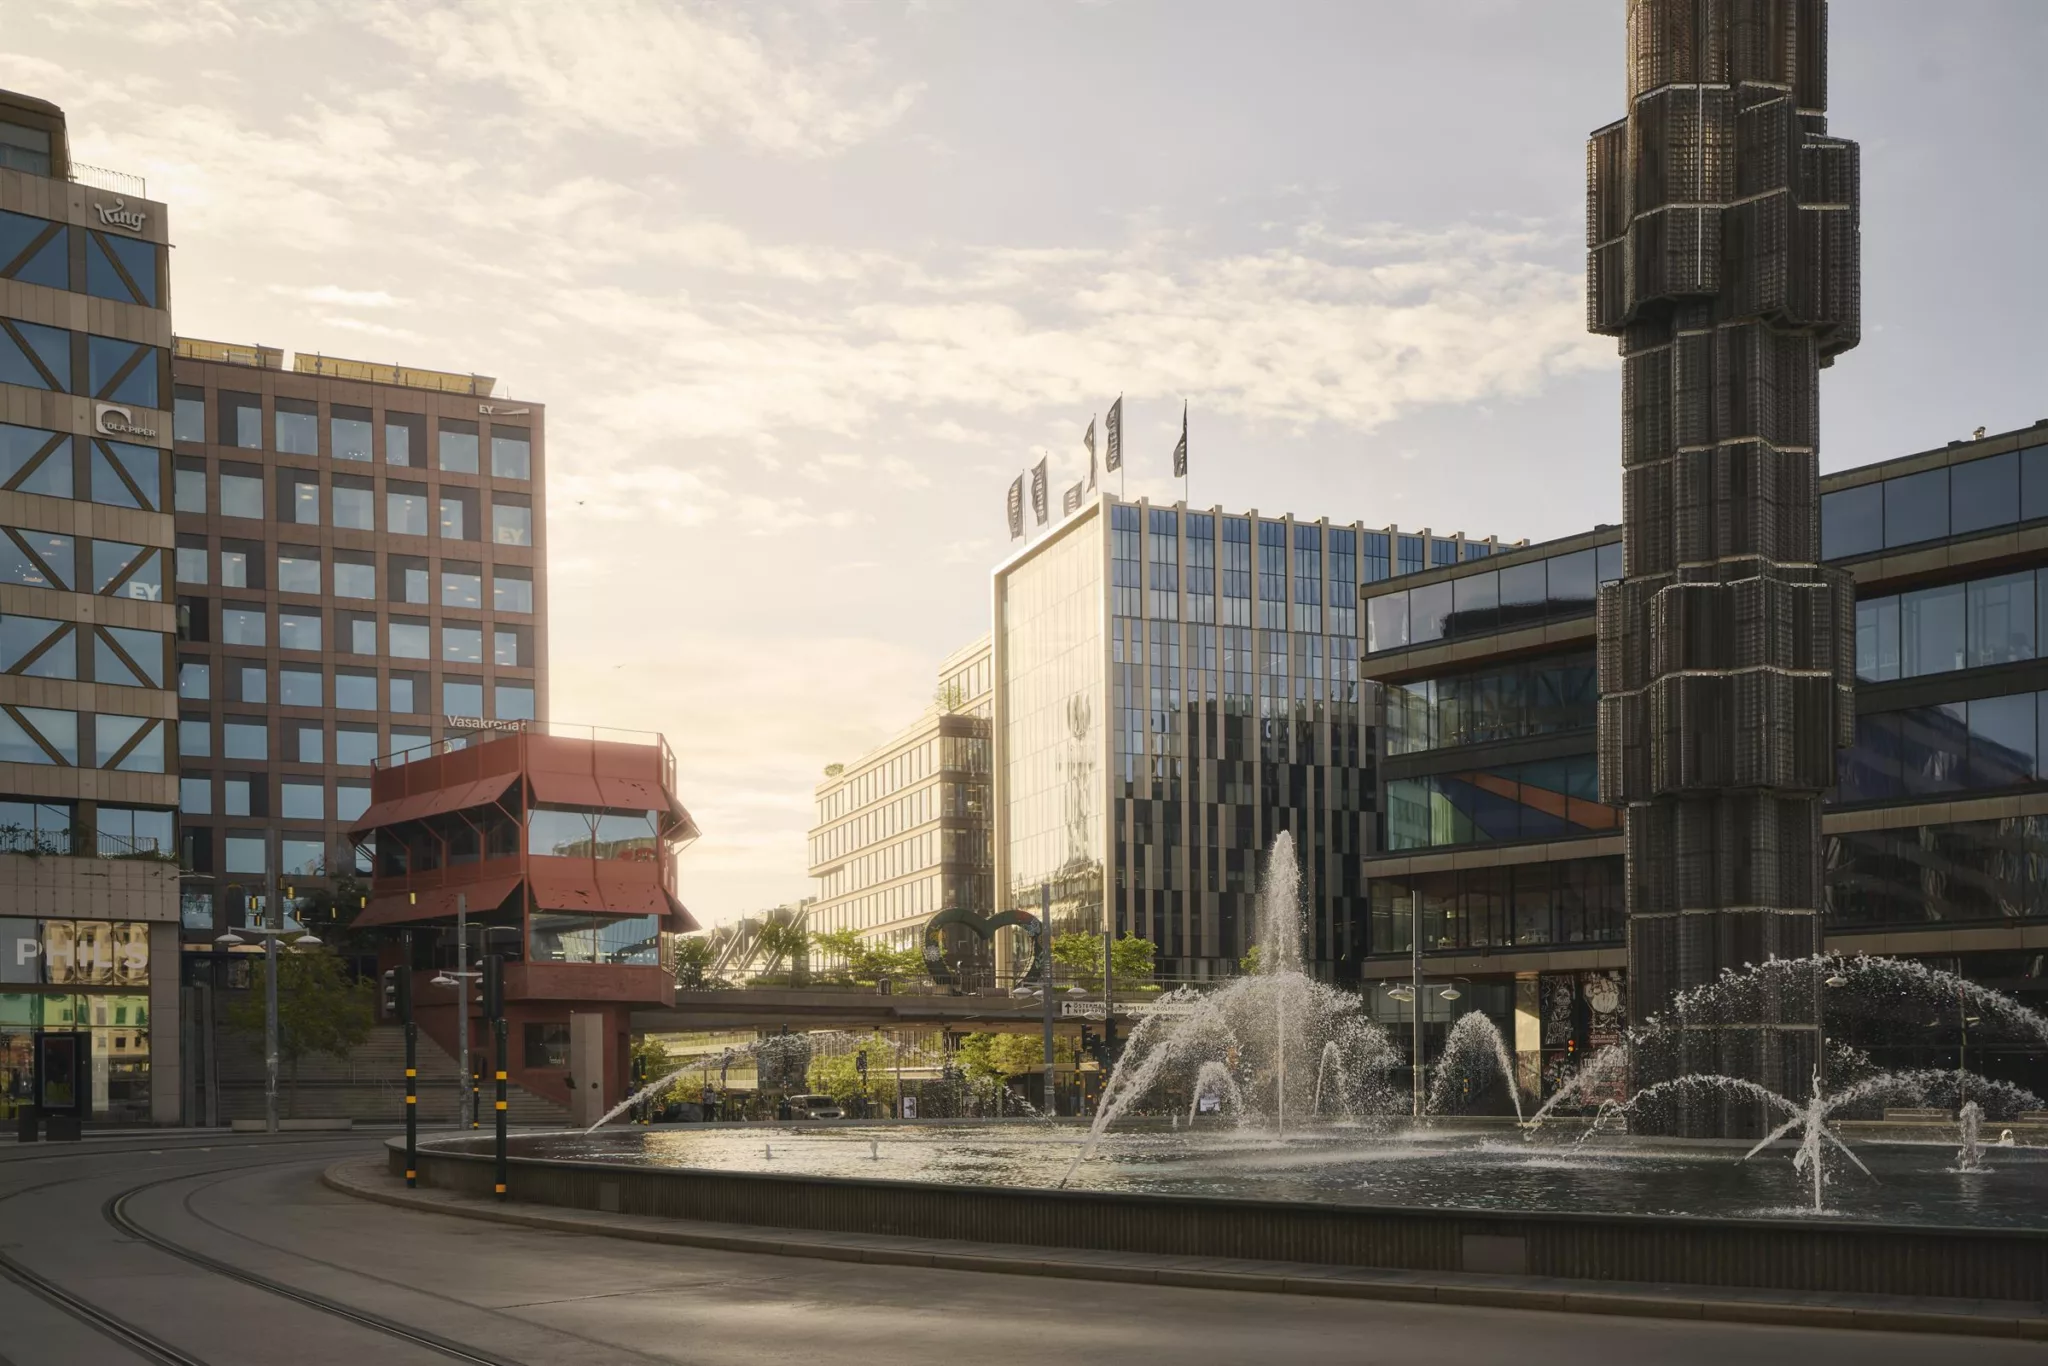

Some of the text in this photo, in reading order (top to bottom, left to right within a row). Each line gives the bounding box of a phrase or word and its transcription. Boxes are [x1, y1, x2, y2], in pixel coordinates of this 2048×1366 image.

[94, 198, 146, 231] King
[479, 404, 494, 414] EY
[108, 423, 156, 437] DLA PIPER
[499, 526, 524, 544] EY
[129, 581, 161, 601] EY
[17, 938, 148, 969] PHIL'S
